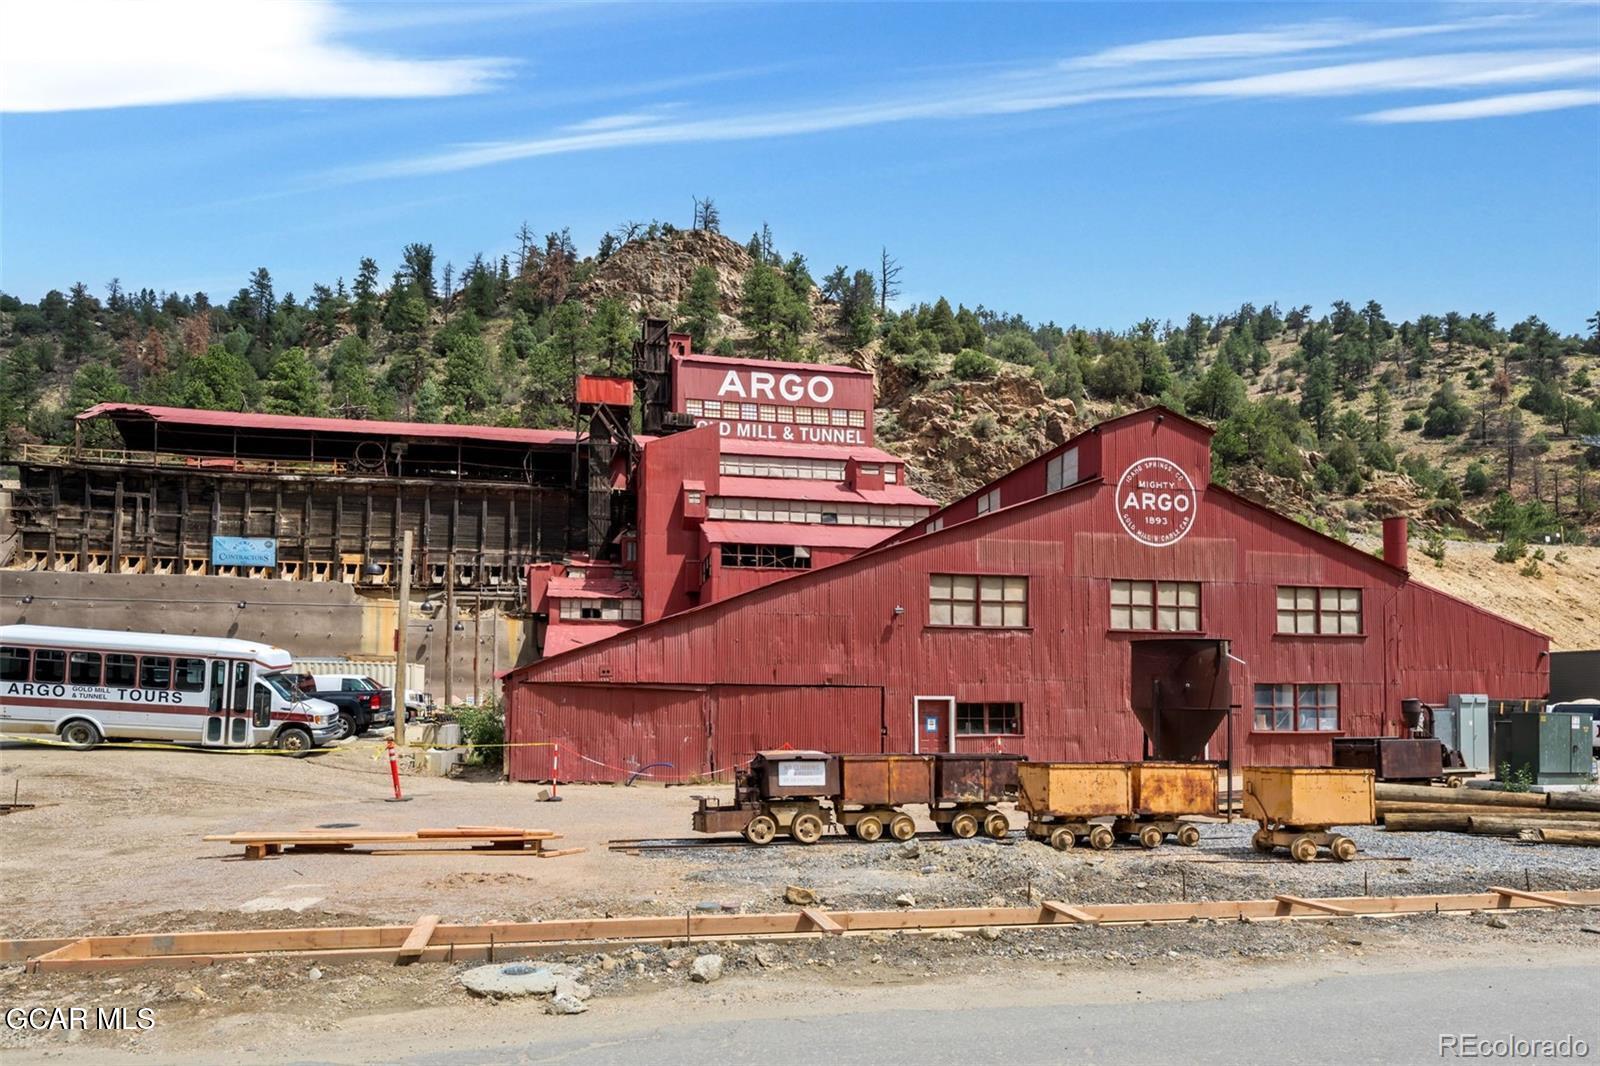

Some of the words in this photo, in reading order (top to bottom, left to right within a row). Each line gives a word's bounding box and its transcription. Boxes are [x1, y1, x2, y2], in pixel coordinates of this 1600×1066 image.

[717, 370, 834, 403] ARGO
[736, 422, 777, 439] MILL
[782, 426, 795, 440] &
[799, 427, 866, 444] TUNNEL
[1126, 465, 1142, 482] IDAHO
[1137, 480, 1175, 489] MIGHTY
[1123, 491, 1190, 512] ARGO
[1123, 514, 1135, 530] GOLD
[1145, 516, 1168, 525] 1893
[219, 553, 269, 561] CONTRACTORS
[8, 682, 66, 698] ARGO
[72, 685, 93, 693] GOLD
[79, 692, 108, 700] TUNNEL
[117, 688, 183, 704] TOURS
